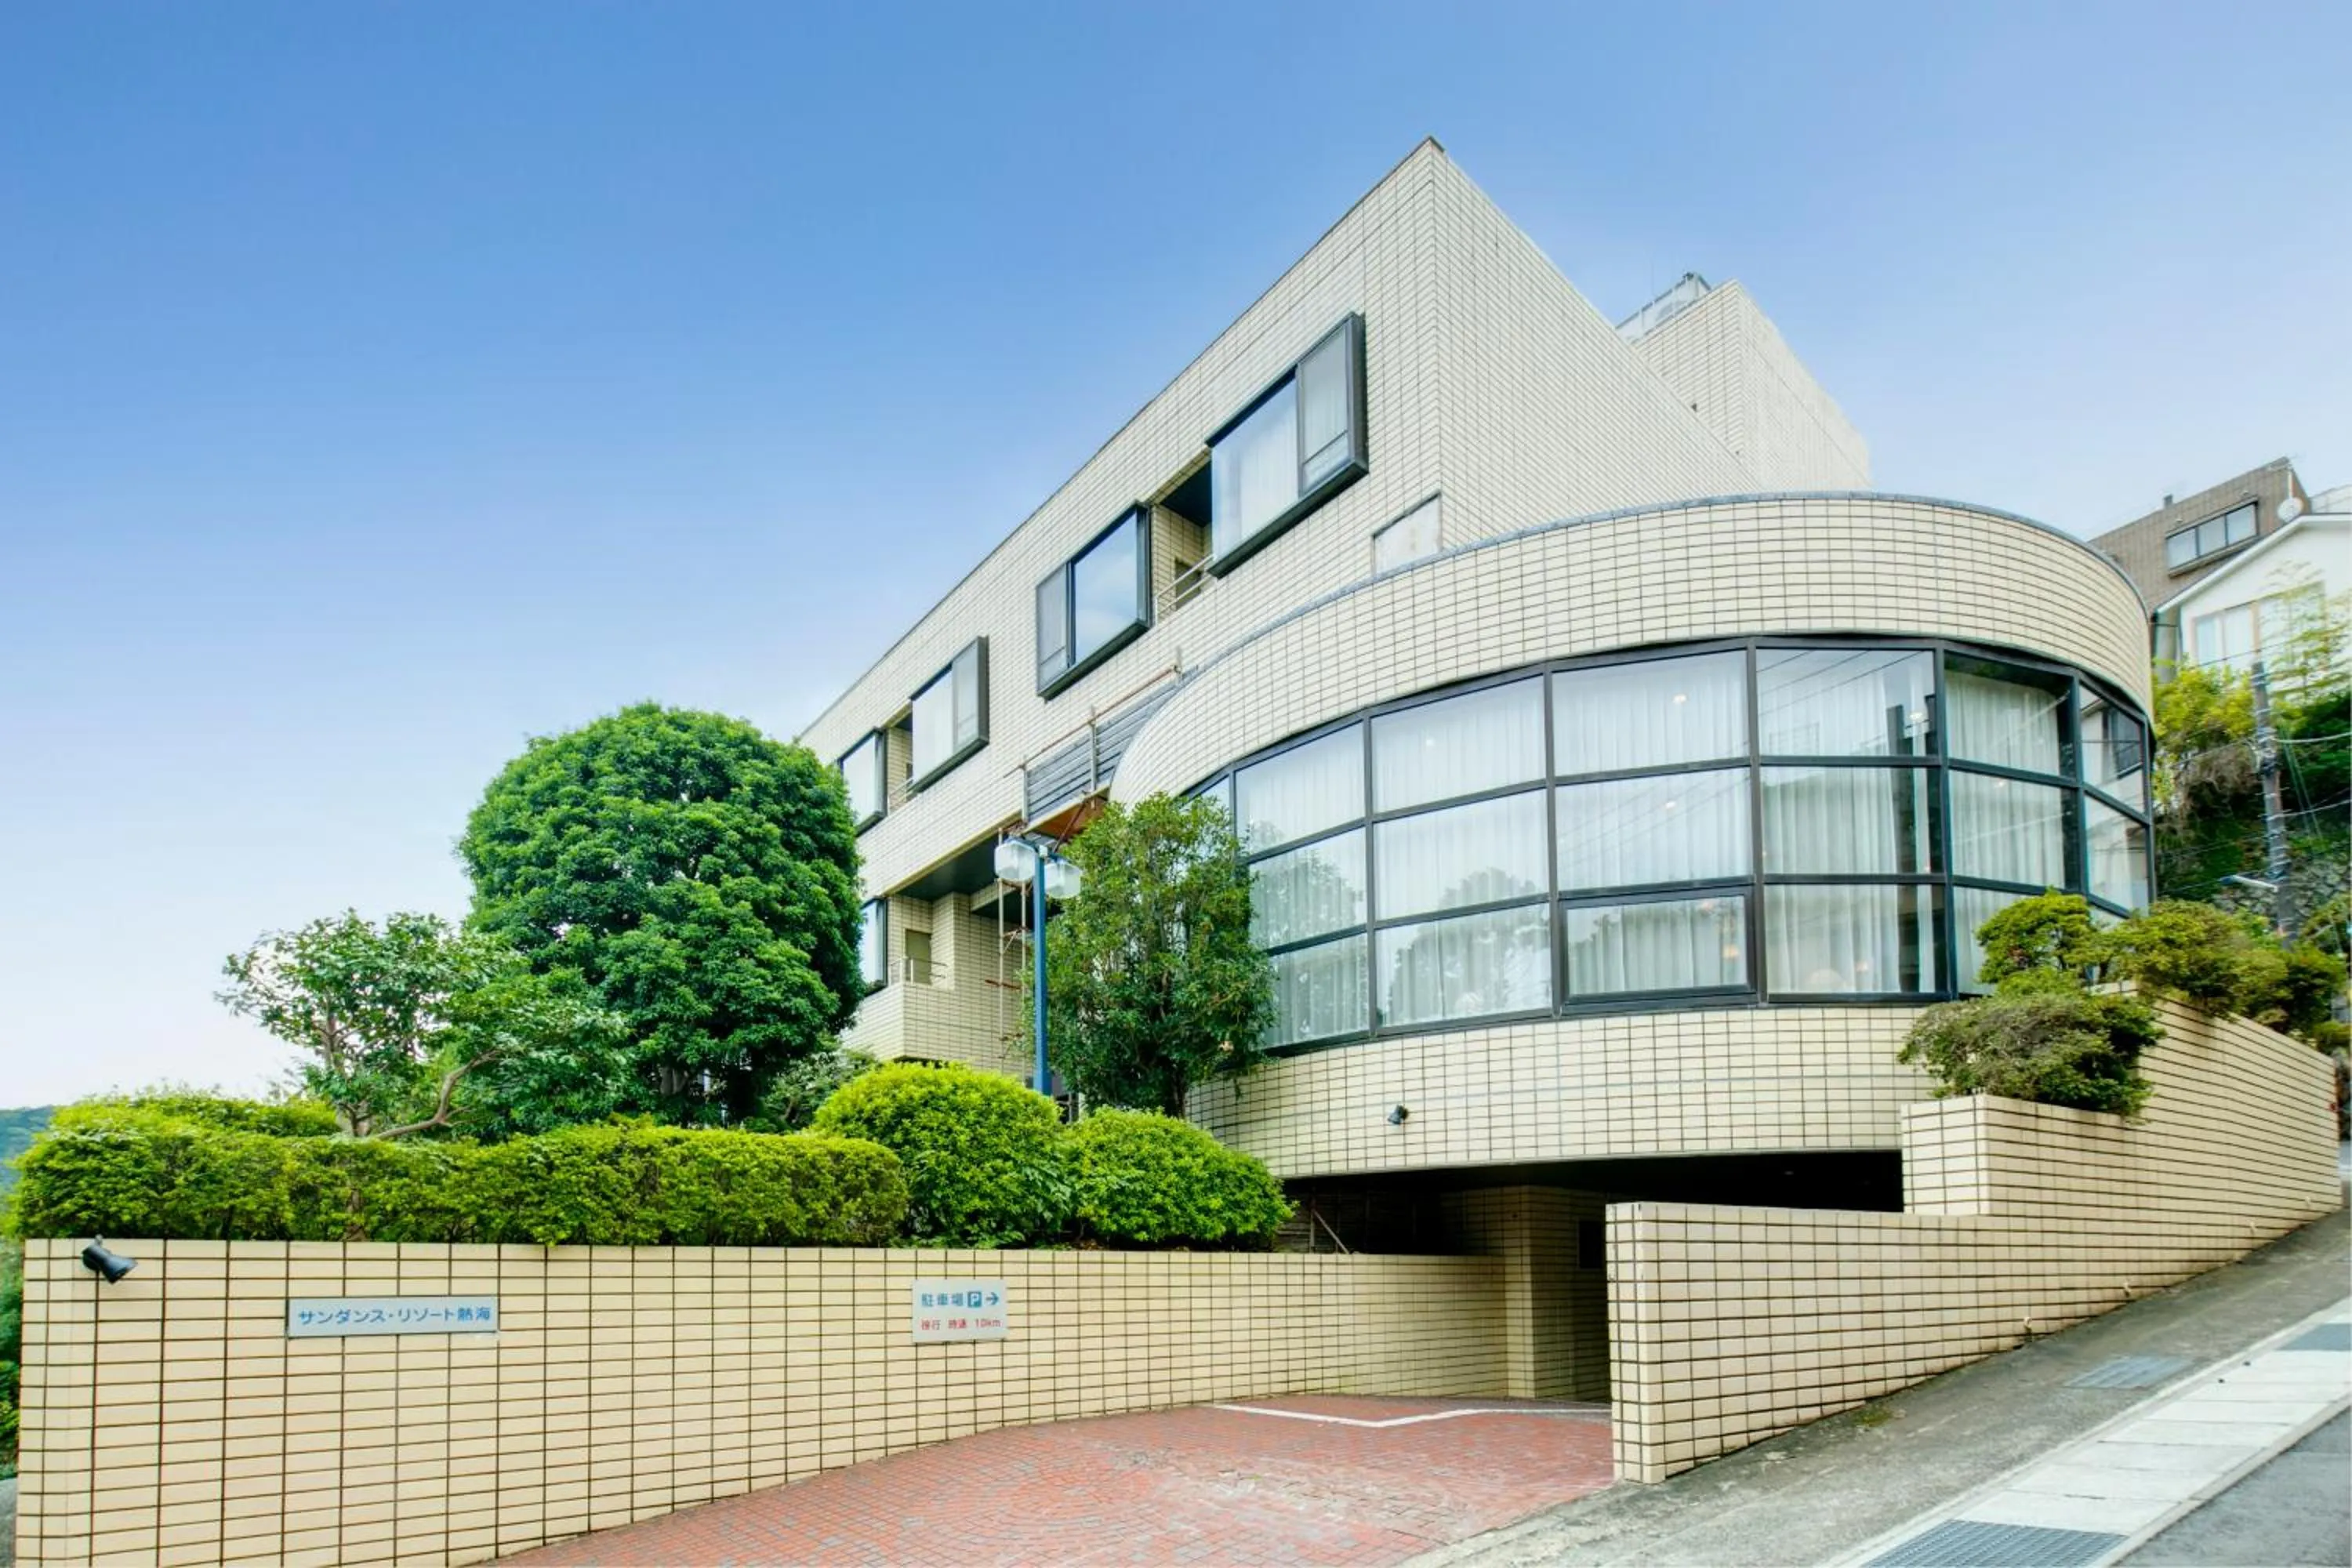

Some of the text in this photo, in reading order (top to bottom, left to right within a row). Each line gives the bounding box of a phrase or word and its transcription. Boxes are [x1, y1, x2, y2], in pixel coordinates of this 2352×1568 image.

[920, 1292, 964, 1307] 駐車場
[298, 1307, 492, 1325] サンダンス・リゾート熱海
[975, 1318, 1002, 1328] 10km
